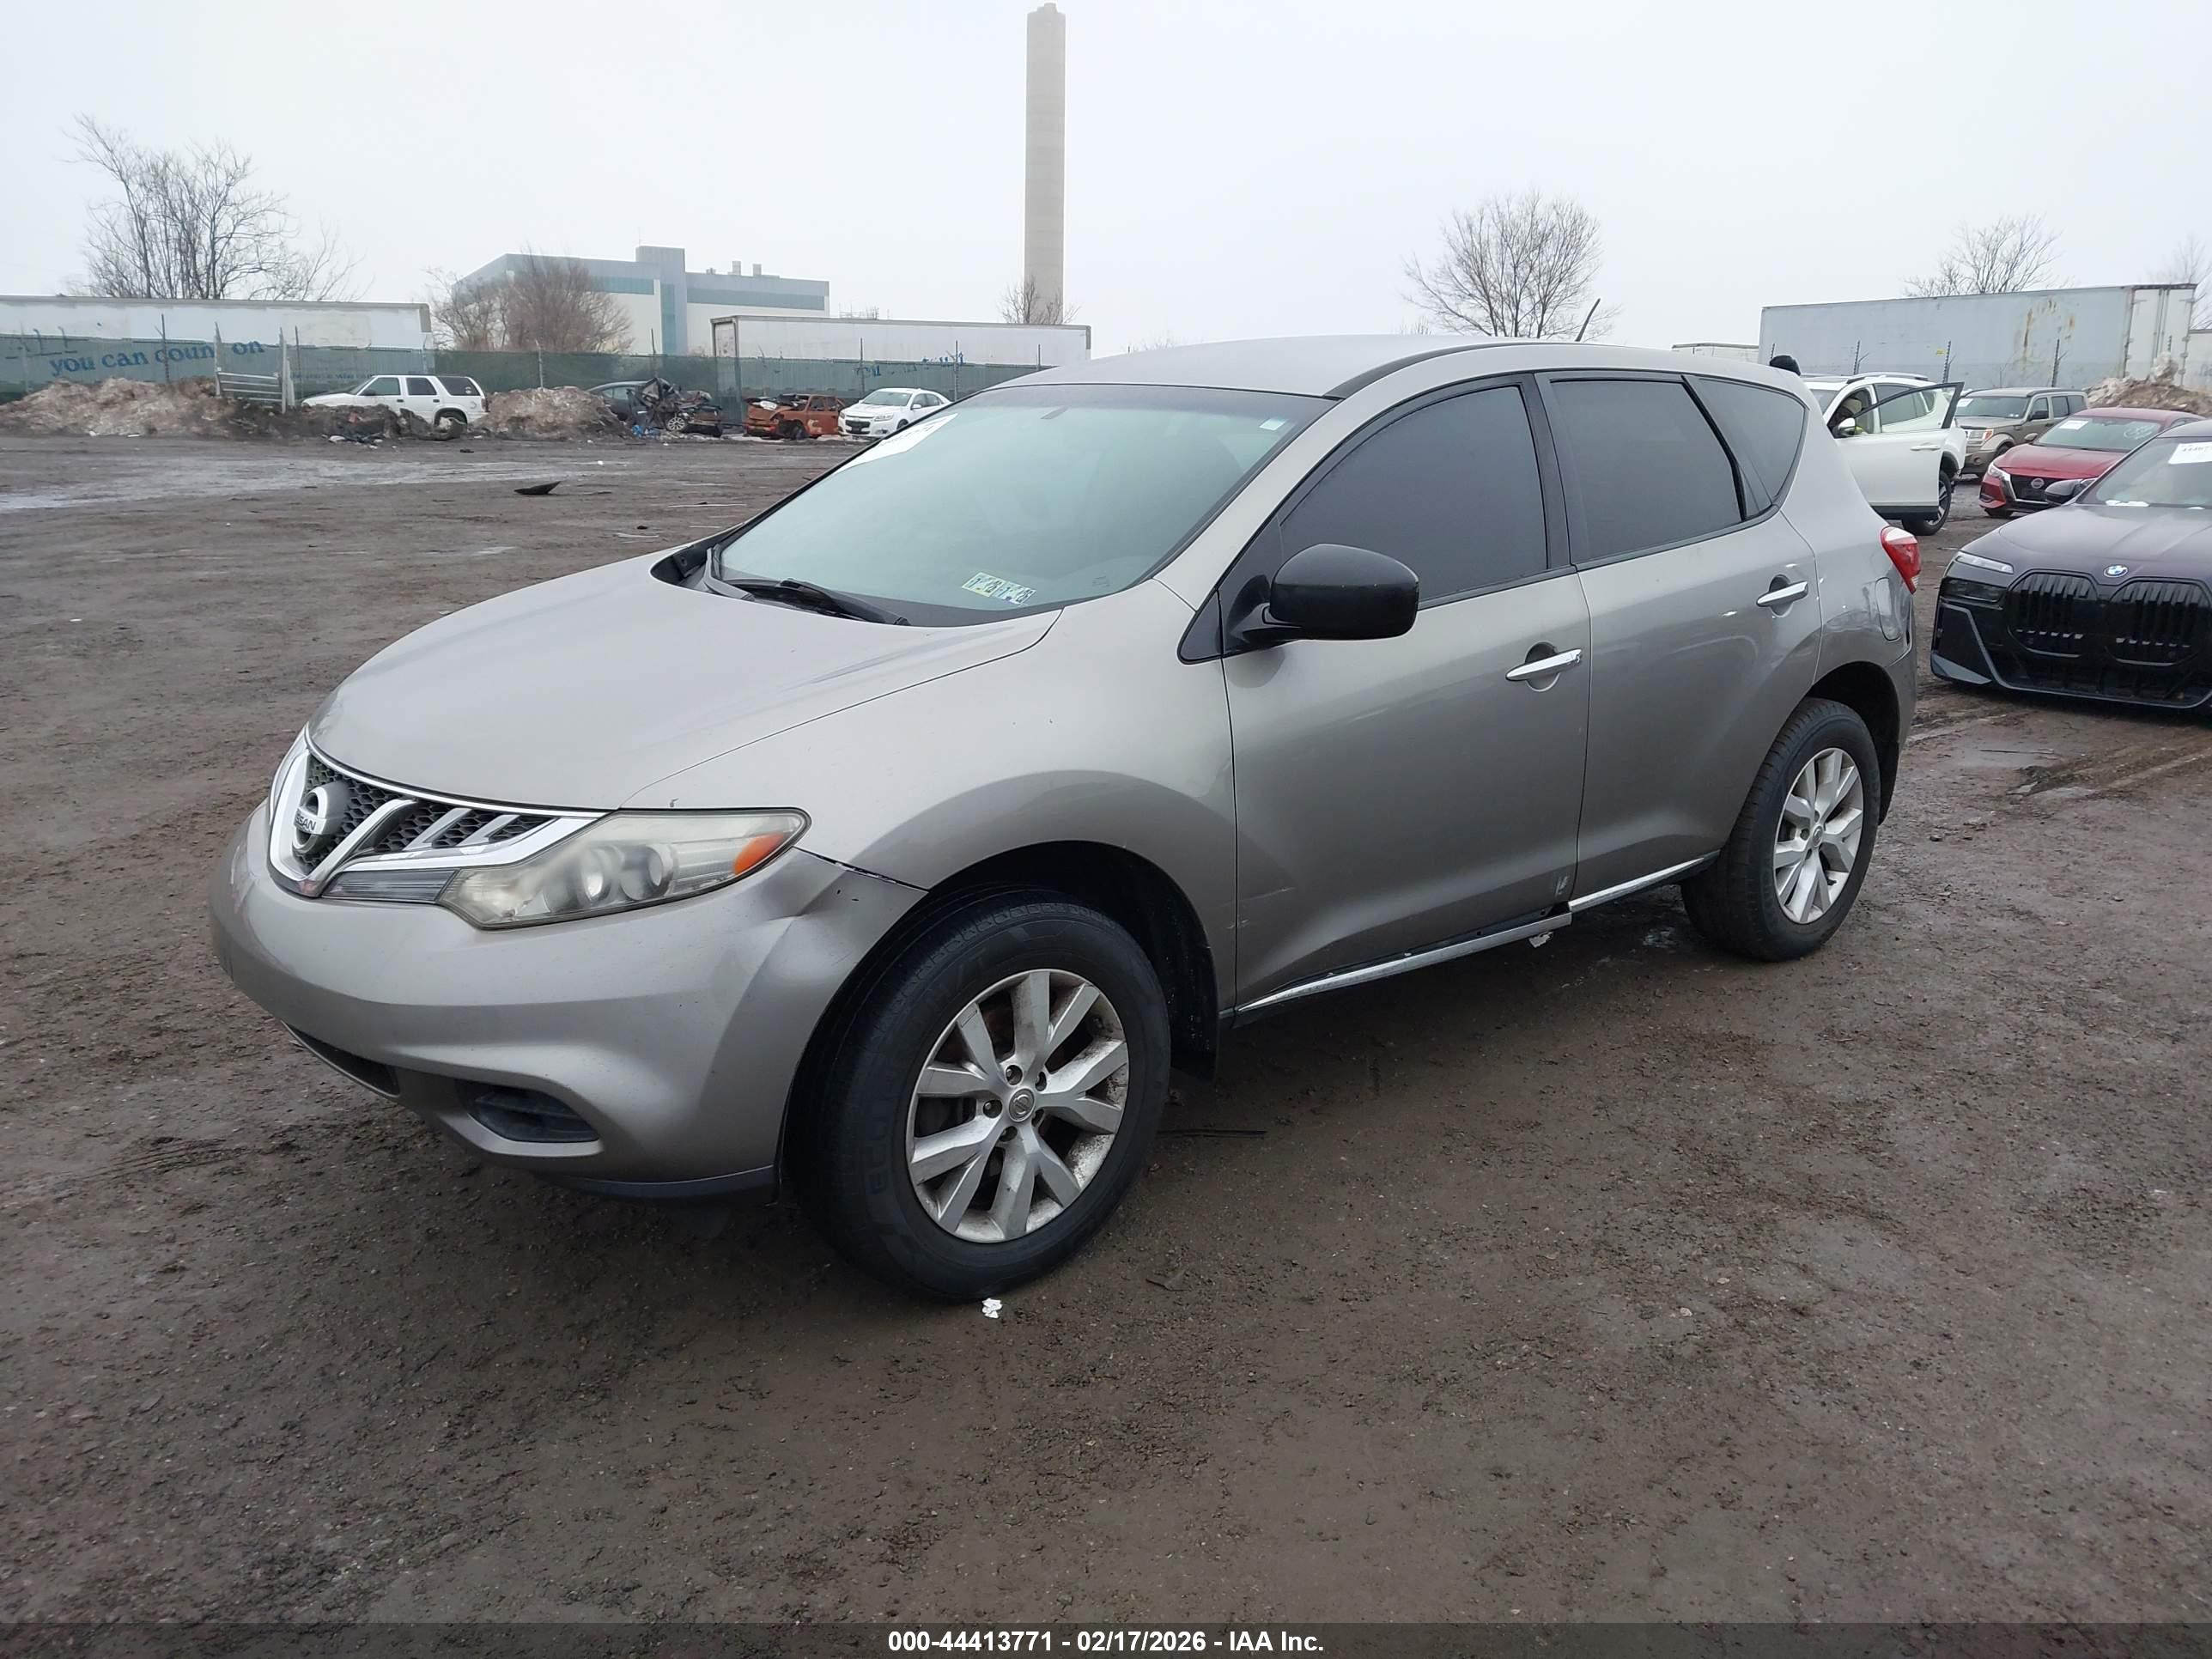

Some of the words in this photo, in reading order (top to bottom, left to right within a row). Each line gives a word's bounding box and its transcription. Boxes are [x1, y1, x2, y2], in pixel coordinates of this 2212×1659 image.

[50, 355, 95, 376] you
[101, 351, 149, 368] can
[155, 344, 216, 363] coun
[233, 340, 264, 356] on
[295, 812, 317, 831] SSAN
